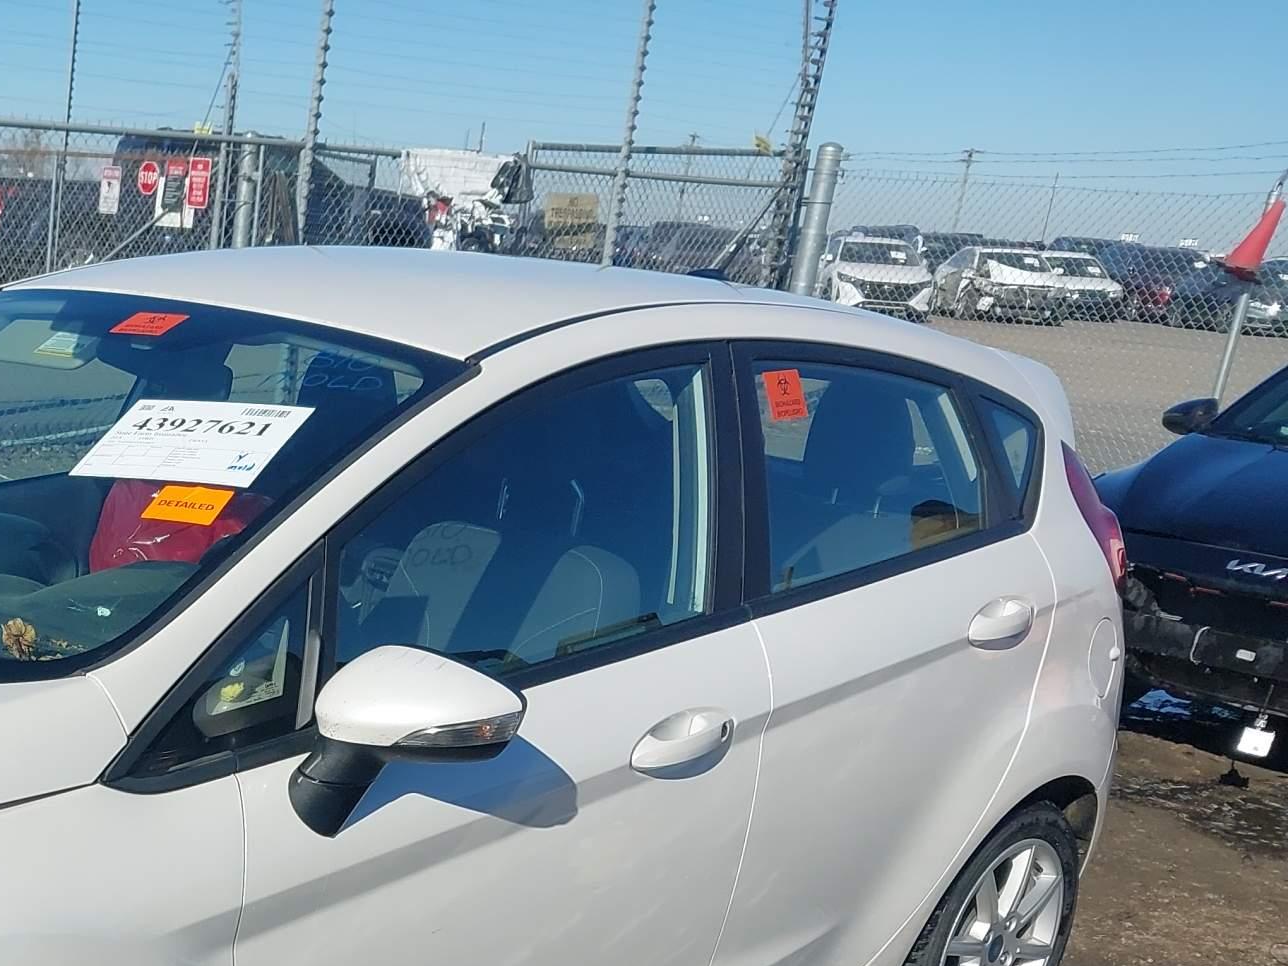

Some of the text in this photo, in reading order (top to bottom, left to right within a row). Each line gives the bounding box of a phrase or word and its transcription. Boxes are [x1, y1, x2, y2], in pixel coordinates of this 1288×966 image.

[140, 171, 158, 185] STOP
[132, 416, 274, 437] 43927621
[157, 499, 215, 512] DETAILED
